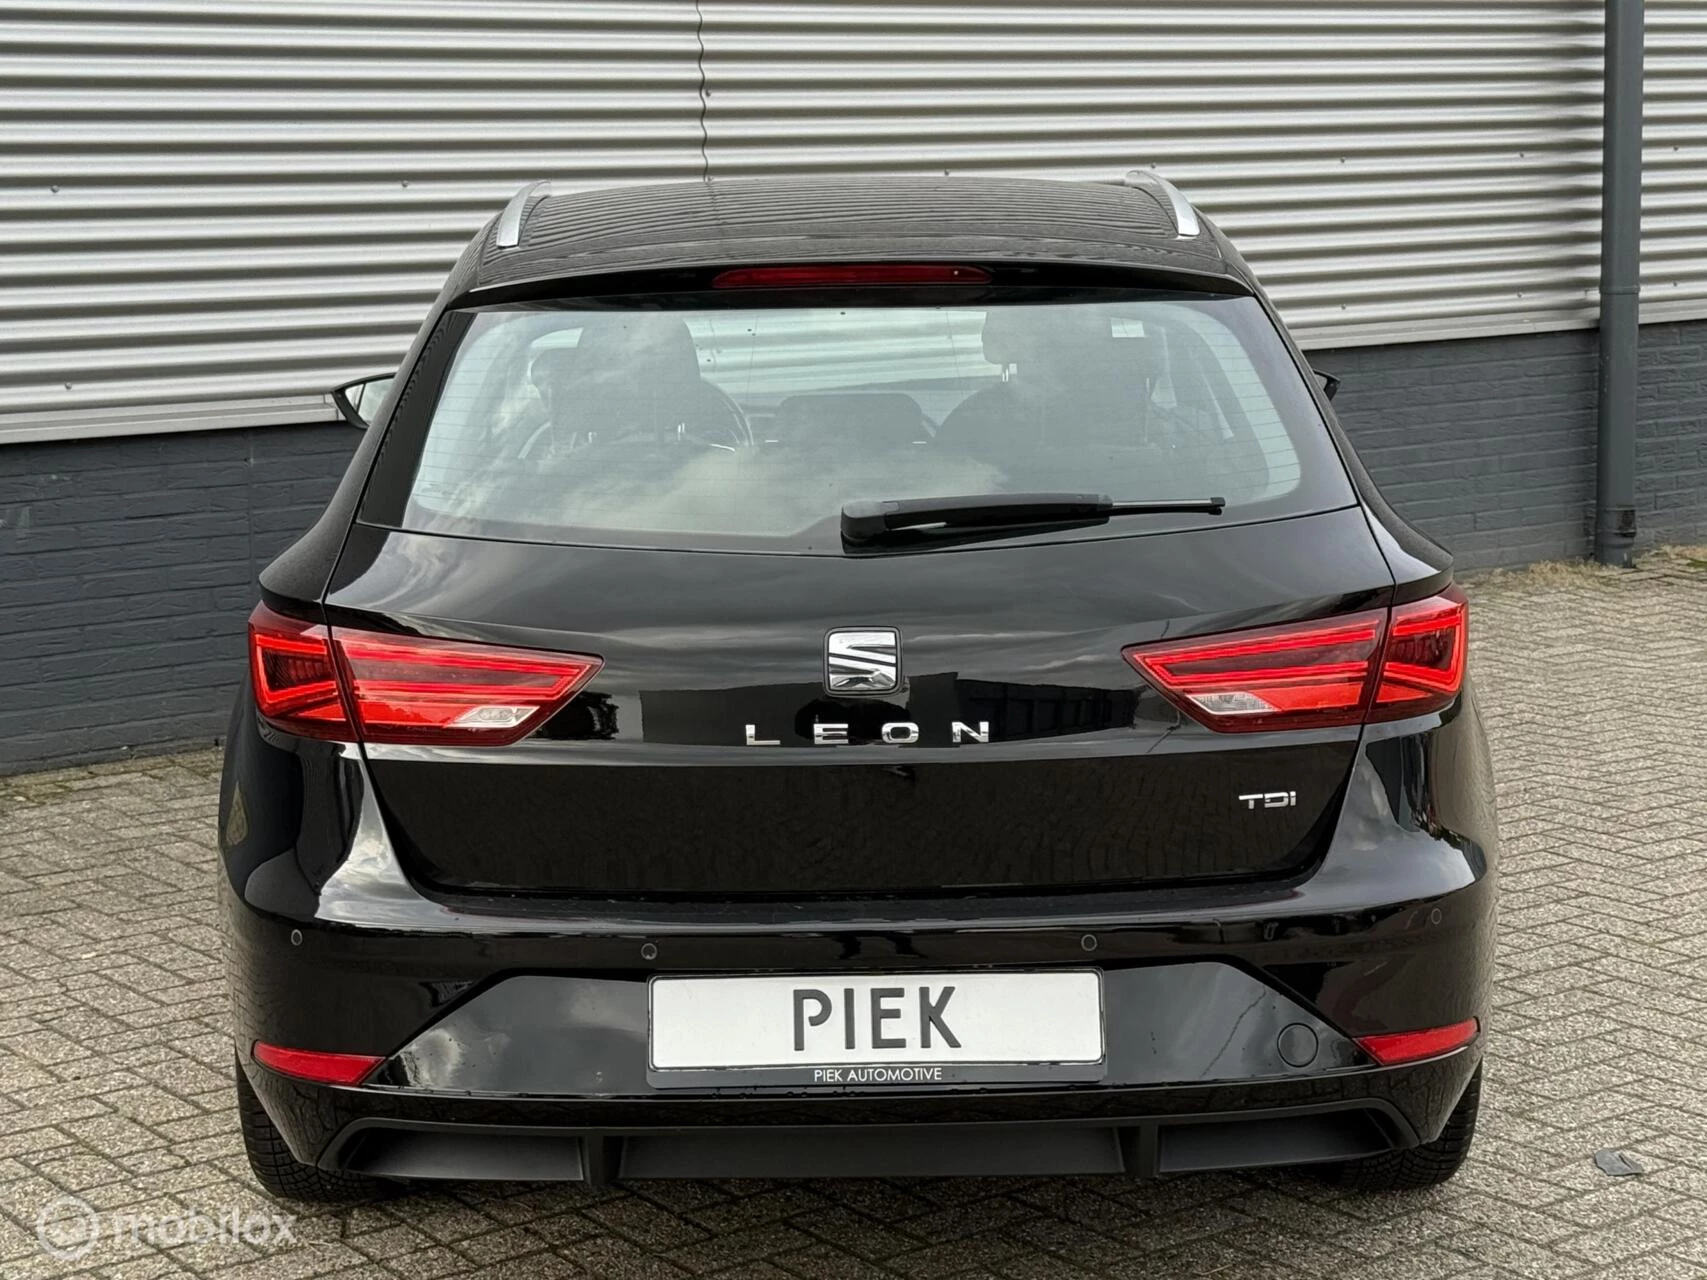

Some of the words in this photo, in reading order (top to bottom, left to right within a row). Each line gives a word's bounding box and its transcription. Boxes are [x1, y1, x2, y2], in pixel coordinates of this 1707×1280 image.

[745, 721, 989, 745] LEON
[793, 986, 962, 1051] PIEK
[813, 1068, 844, 1082] PIEK
[847, 1067, 942, 1082] AUTOMOTIVE
